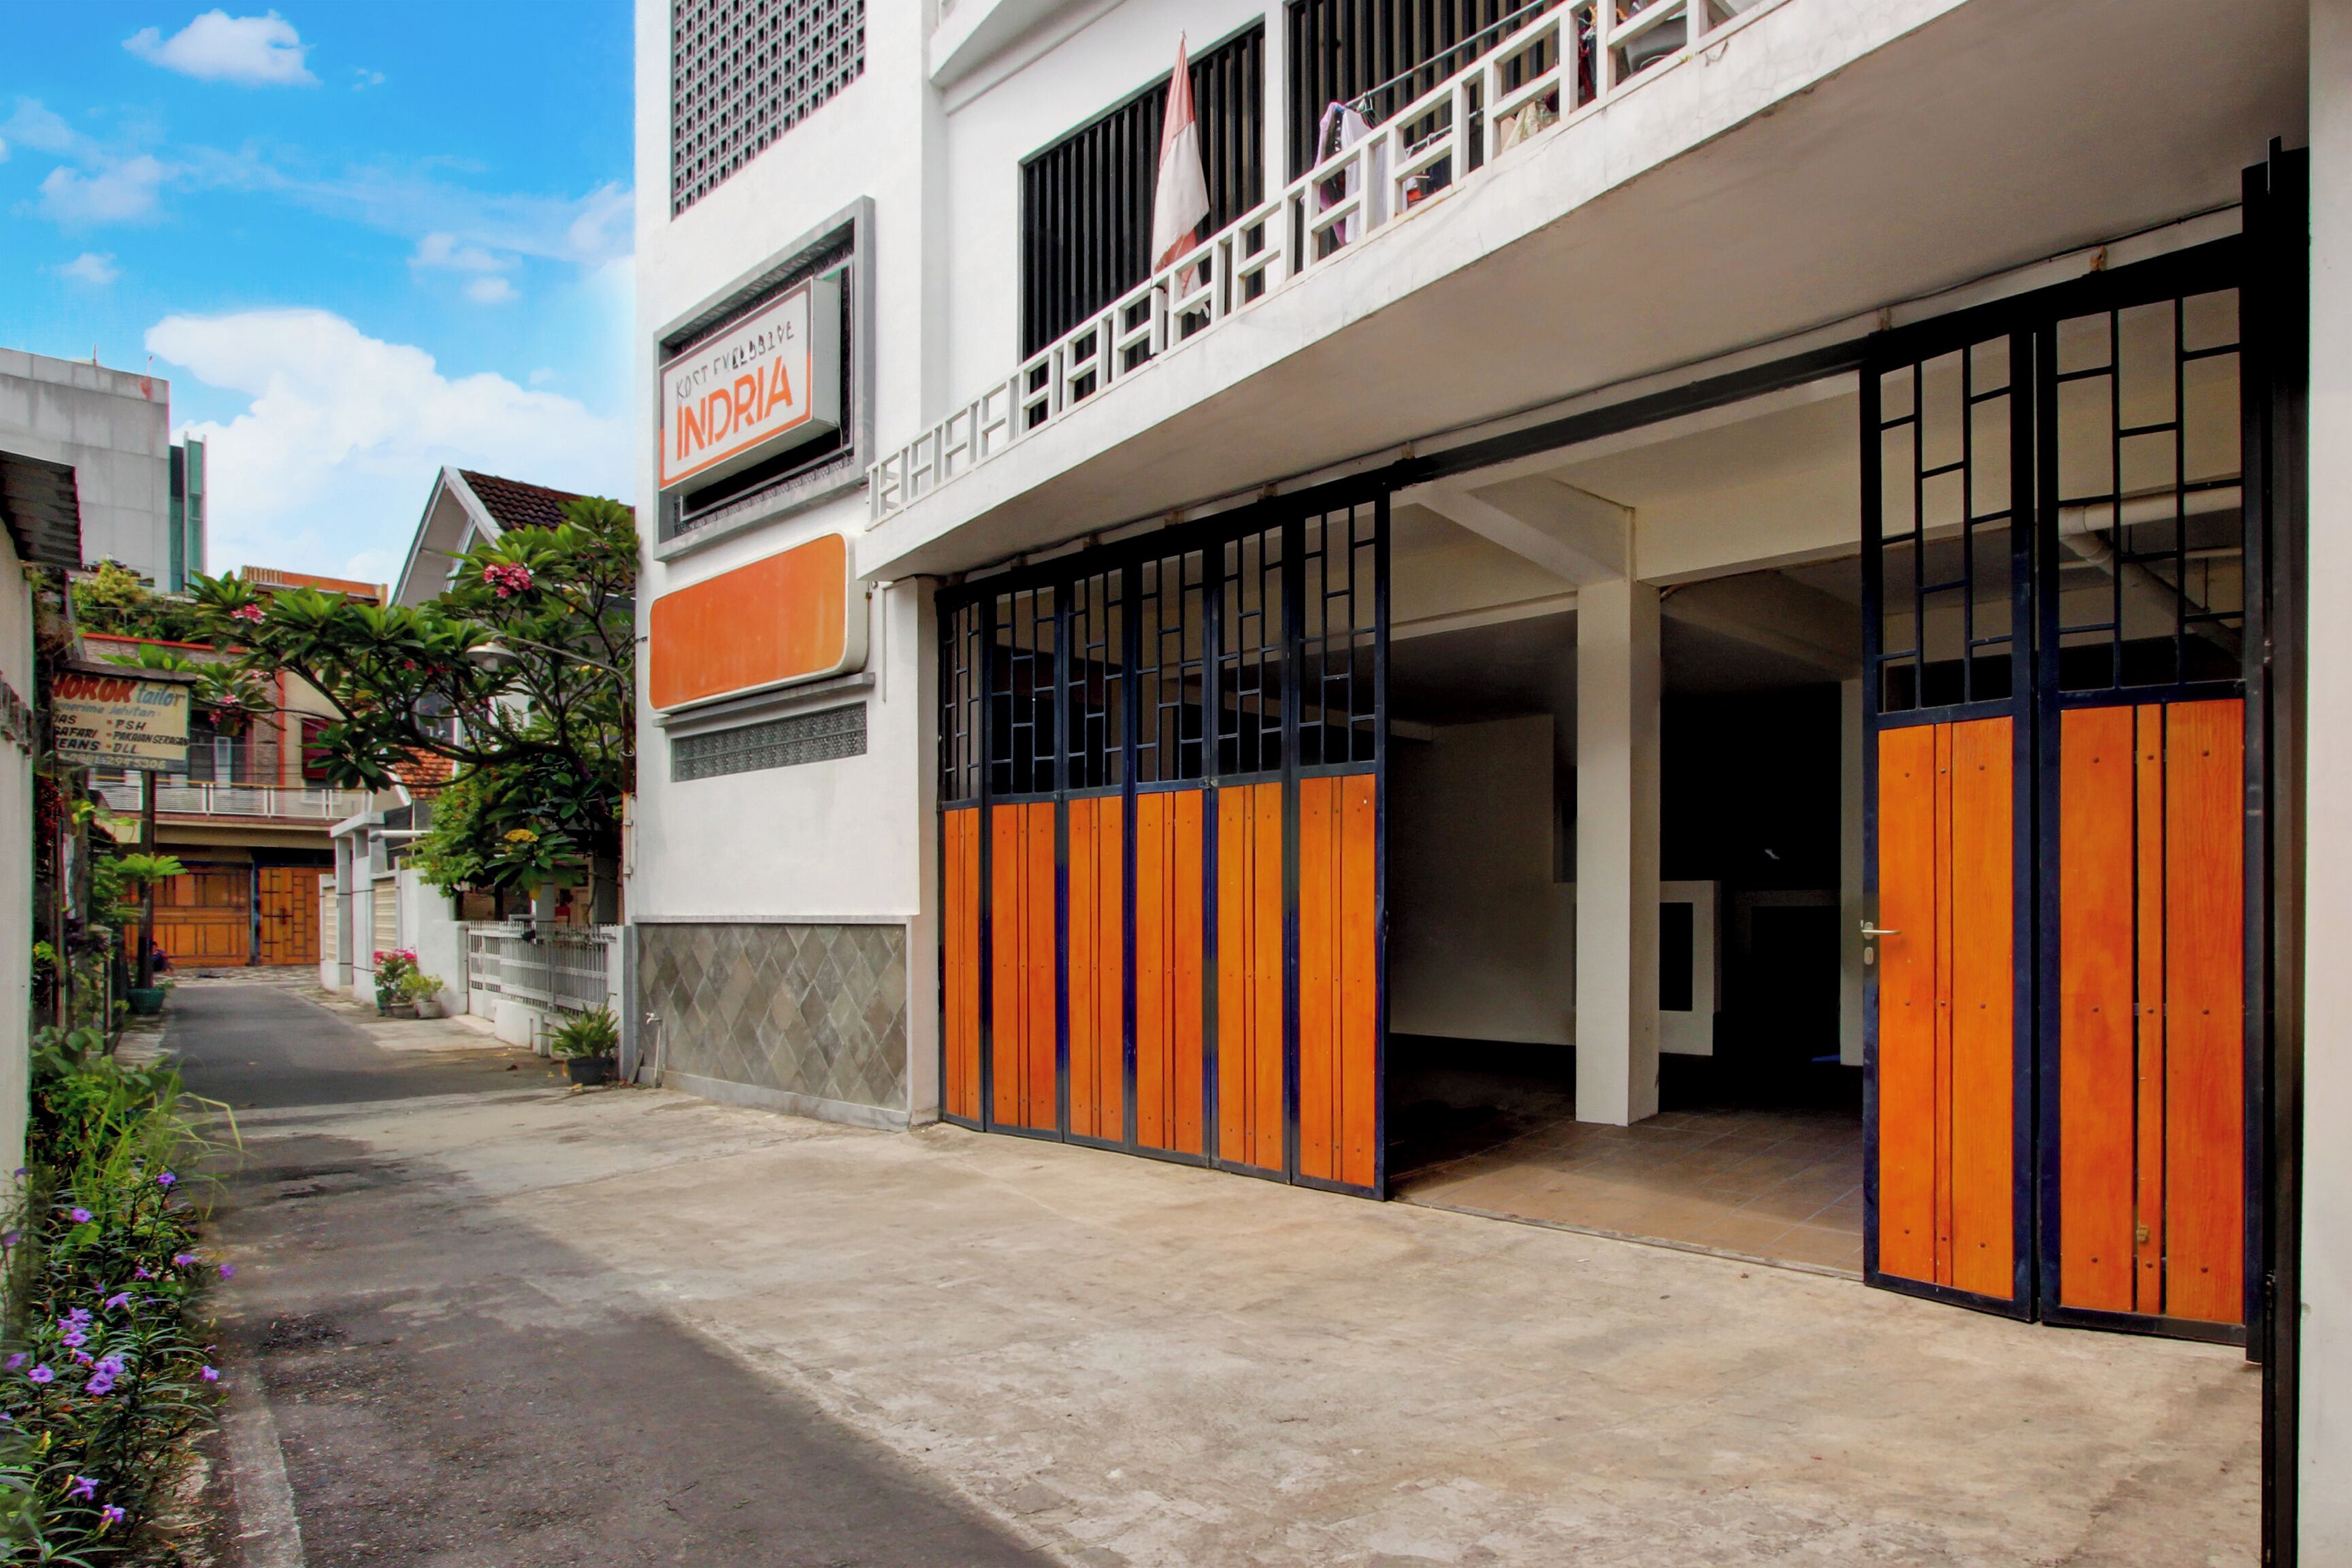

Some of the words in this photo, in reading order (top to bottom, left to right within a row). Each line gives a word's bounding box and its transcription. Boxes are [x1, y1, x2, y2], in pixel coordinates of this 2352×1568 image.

[676, 355, 793, 461] INDRIA
[137, 681, 186, 707] tailor
[114, 719, 147, 731] PSH
[113, 731, 152, 743] PAKAIAN
